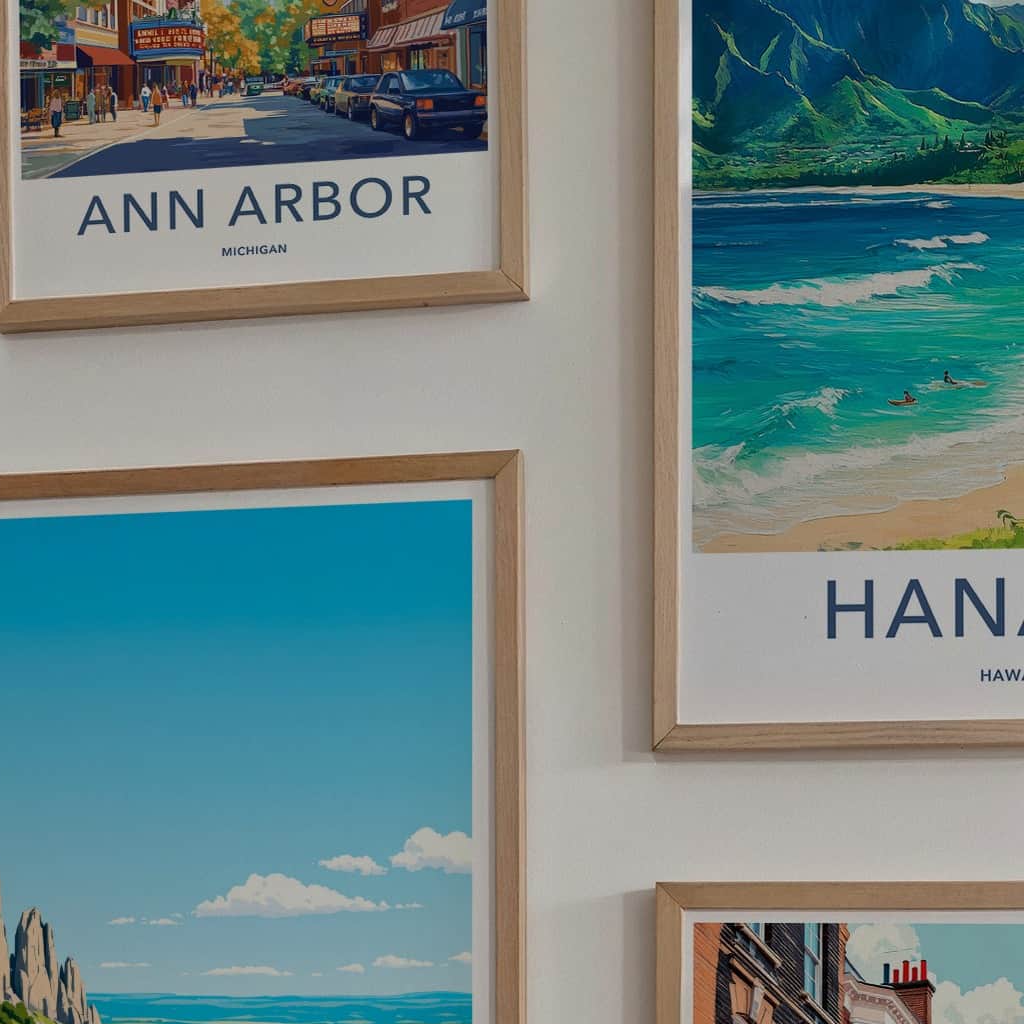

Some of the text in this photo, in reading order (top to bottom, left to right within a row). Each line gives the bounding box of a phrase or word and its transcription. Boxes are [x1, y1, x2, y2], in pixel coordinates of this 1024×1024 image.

[77, 175, 432, 236] ANN ARBOR
[221, 243, 288, 257] MICHIGAN
[826, 577, 1024, 639] HAN
[980, 668, 1024, 682] HAW
